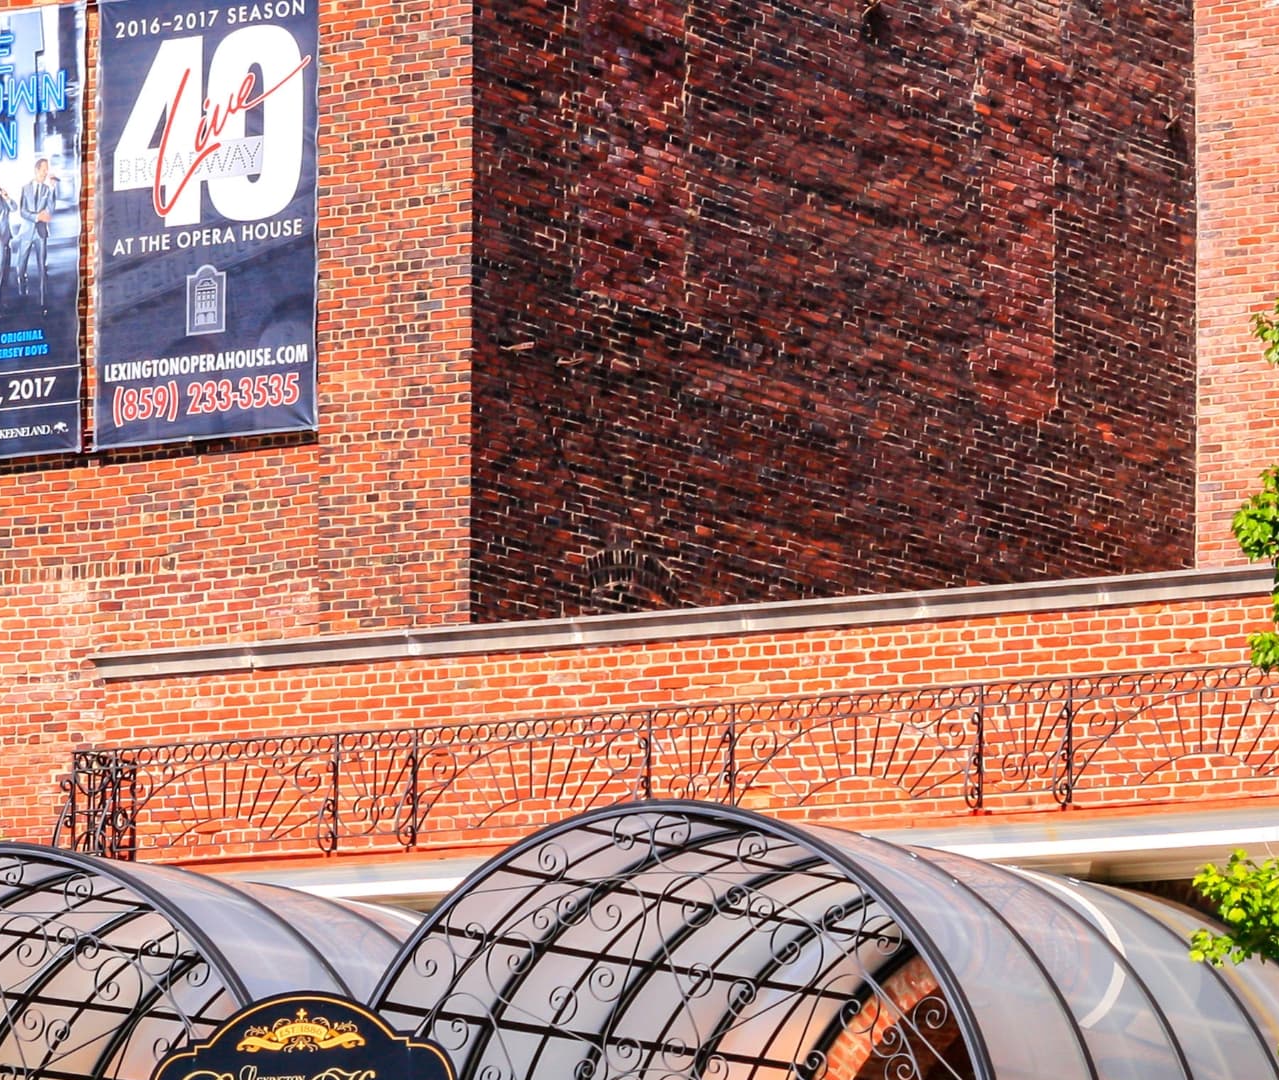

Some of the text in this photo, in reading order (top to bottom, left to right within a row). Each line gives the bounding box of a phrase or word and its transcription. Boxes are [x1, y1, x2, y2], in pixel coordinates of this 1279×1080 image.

[115, 0, 305, 39] 2016-2017 SEASON
[113, 24, 304, 227] 40
[153, 54, 311, 217] Live
[120, 141, 261, 184] BROADWAY
[112, 218, 302, 256] AT THE OPERA HOUSE
[1, 329, 43, 344] ORIGINAL
[25, 344, 48, 355] BOYS
[104, 344, 308, 383] LEXINGTONOPERAHOUSE.COM
[8, 376, 56, 401] 2017
[113, 372, 300, 428] (859) 233-3535
[0, 424, 51, 440] KEENELAND
